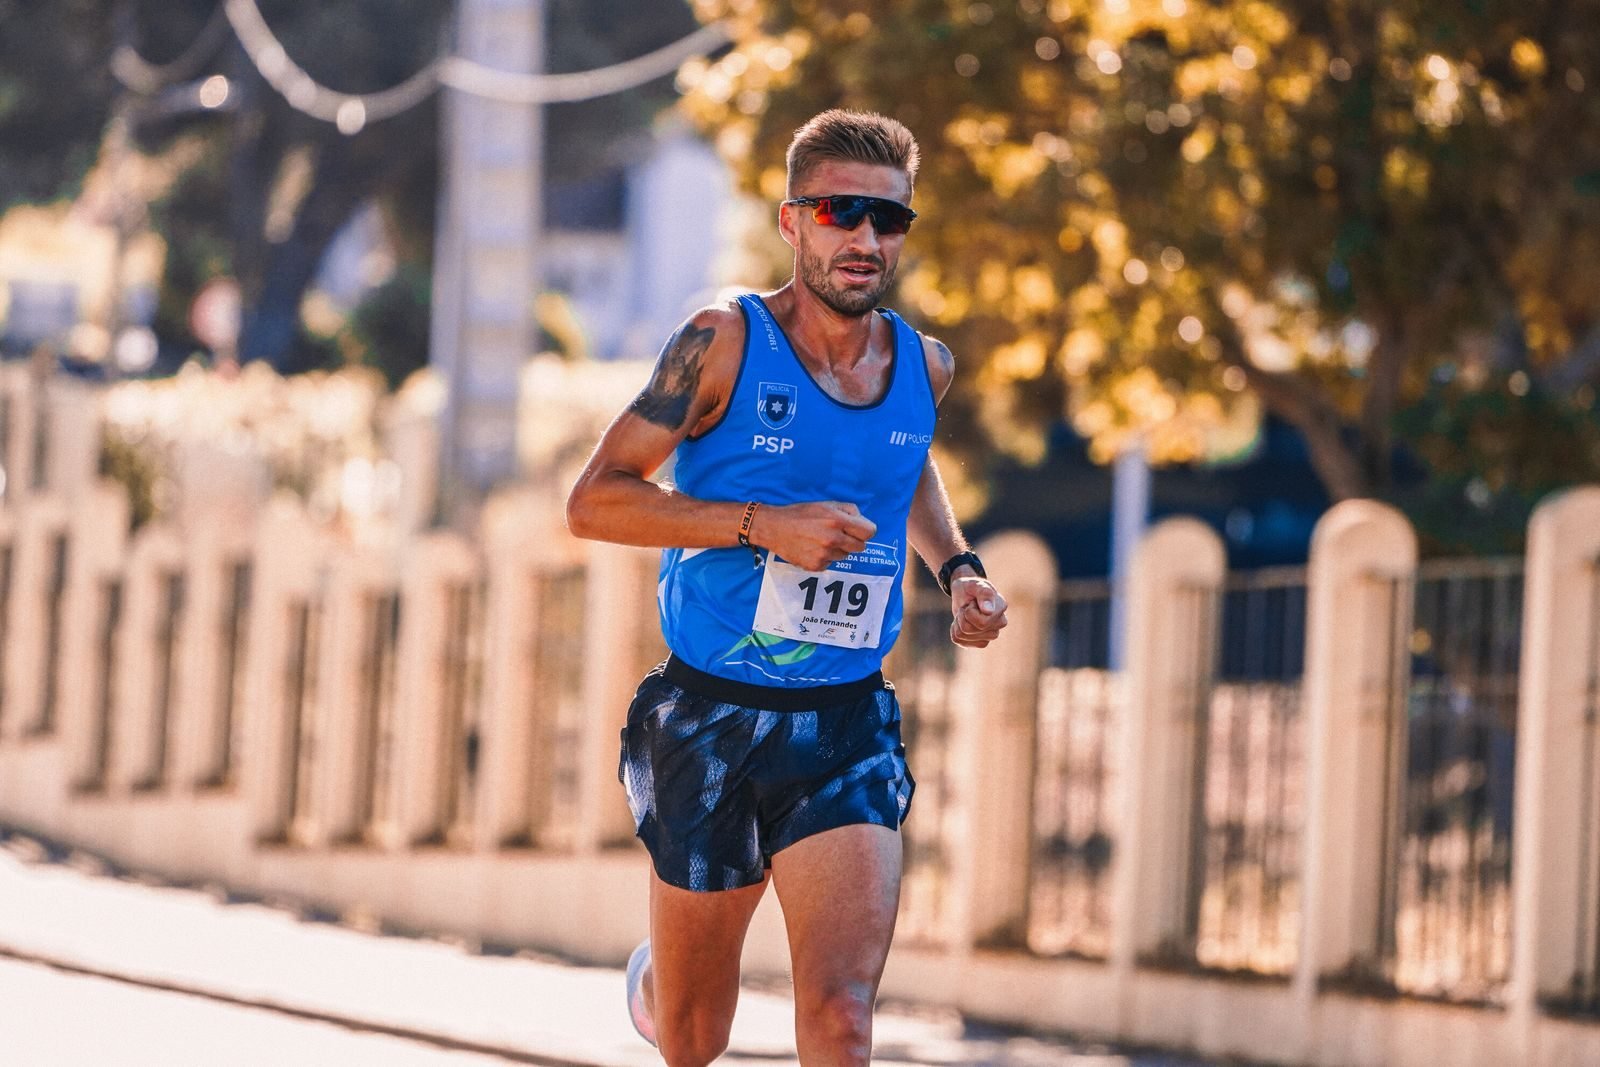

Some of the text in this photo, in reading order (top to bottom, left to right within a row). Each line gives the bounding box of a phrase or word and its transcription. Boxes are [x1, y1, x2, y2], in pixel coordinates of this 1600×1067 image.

[764, 323, 779, 353] SPORT
[752, 434, 795, 455] PSP
[741, 501, 757, 530] ASTER
[835, 561, 852, 570] 2021
[869, 557, 897, 566] ESTRADA
[798, 576, 869, 617] 119
[819, 617, 858, 630] Fernandes
